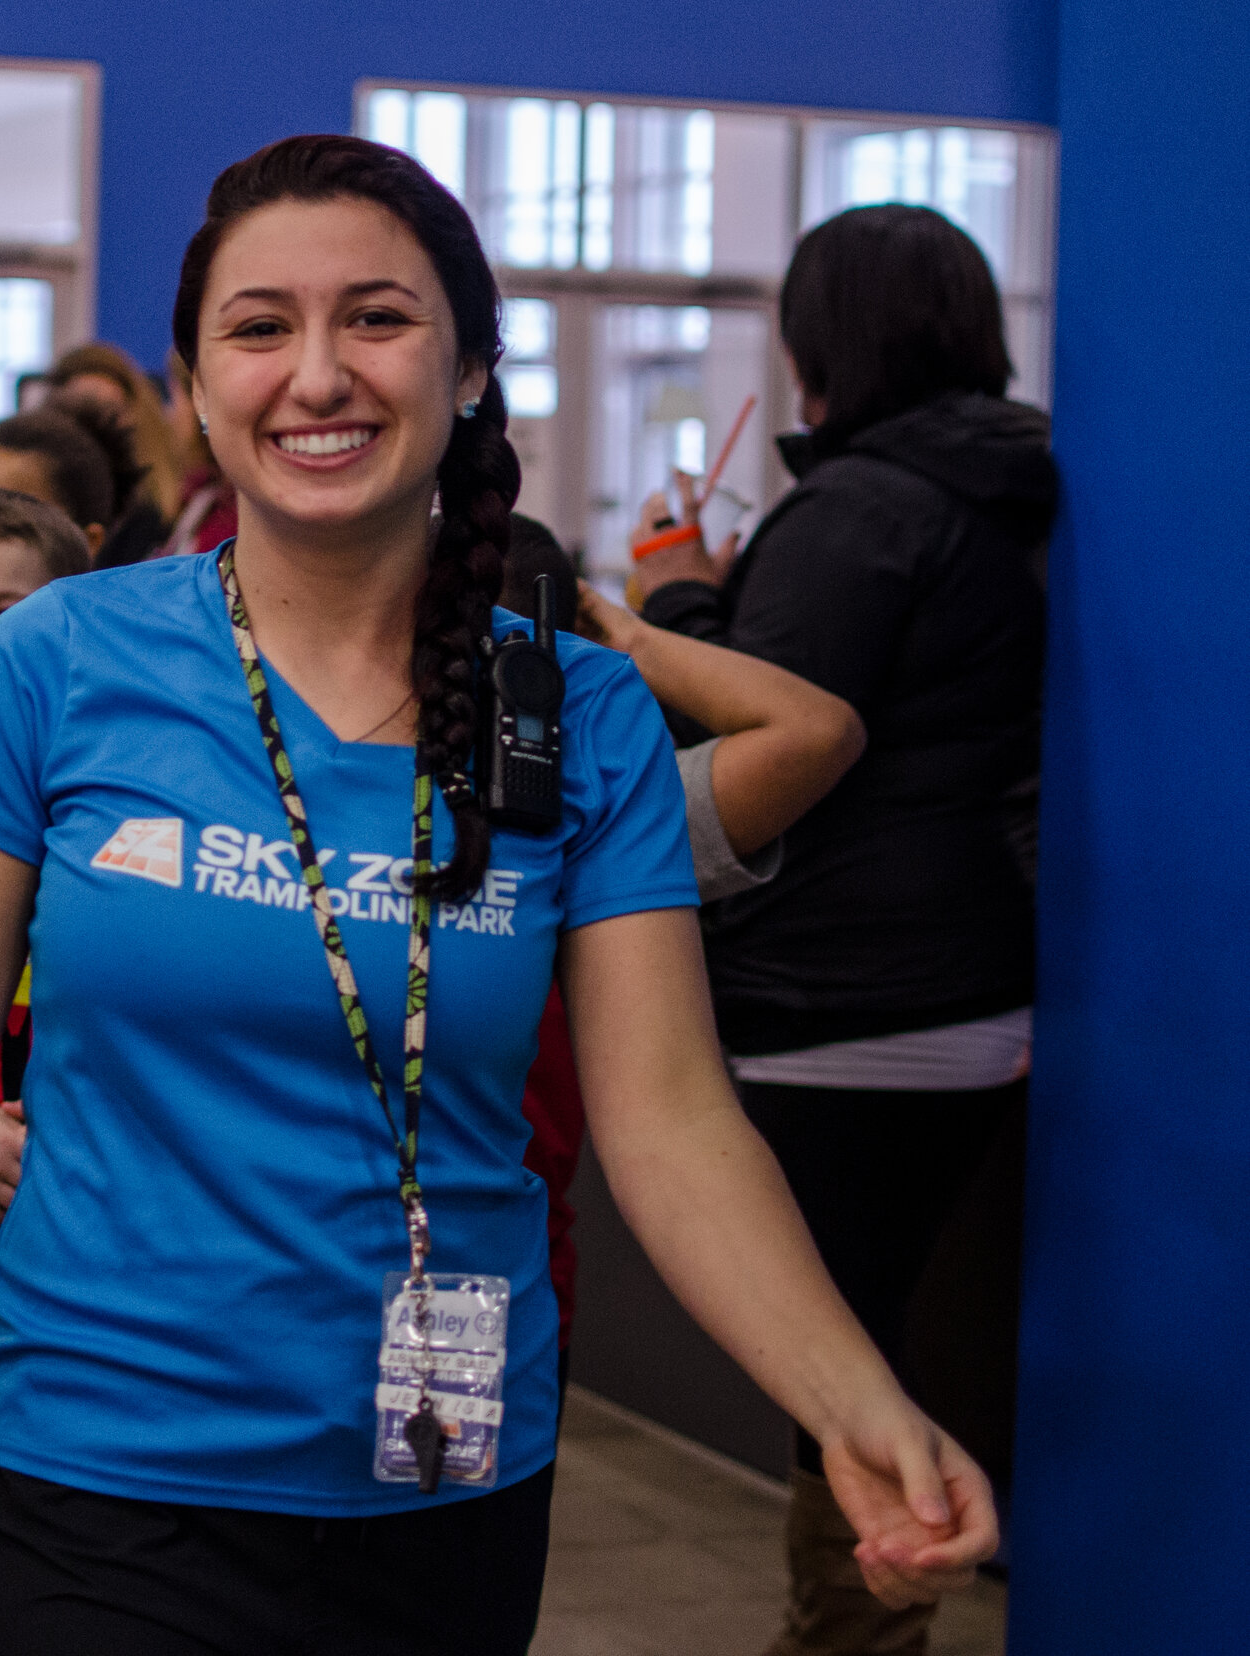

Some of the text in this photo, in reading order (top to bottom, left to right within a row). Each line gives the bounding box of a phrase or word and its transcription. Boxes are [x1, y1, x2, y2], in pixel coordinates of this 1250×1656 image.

[193, 862, 516, 937] TRAMPOLIN PARK
[346, 852, 519, 909] ZOE
[395, 1306, 470, 1338] Ahley
